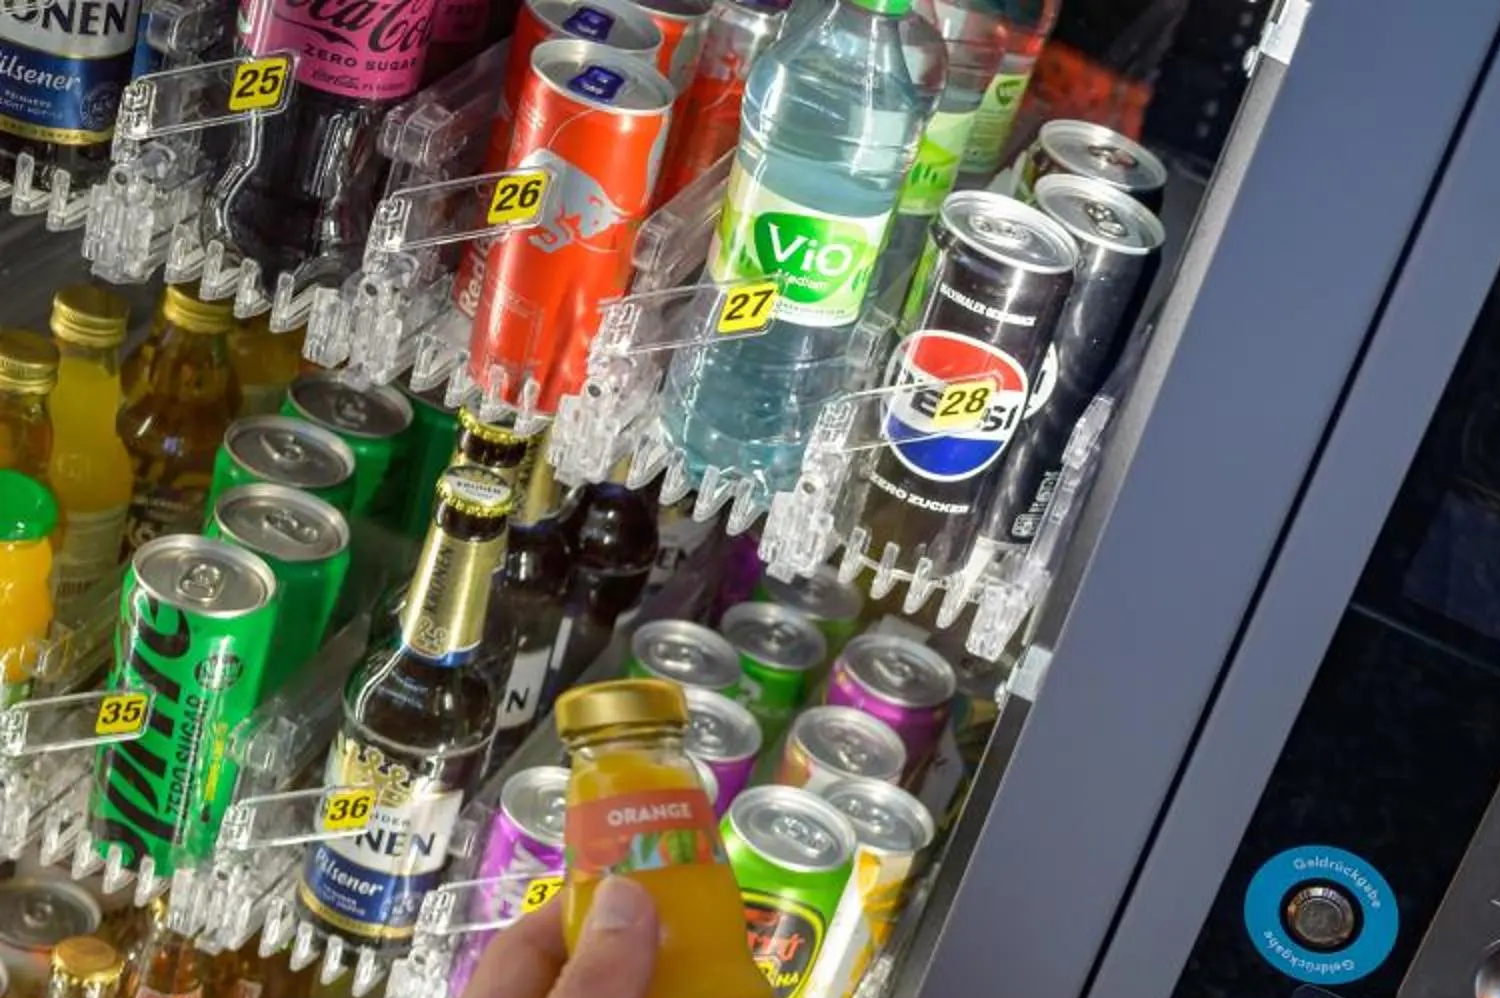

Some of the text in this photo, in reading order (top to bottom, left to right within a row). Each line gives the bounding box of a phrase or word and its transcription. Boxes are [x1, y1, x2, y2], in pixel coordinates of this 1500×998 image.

[303, 43, 417, 72] ZERO SUGAR
[234, 66, 283, 99] 25
[494, 180, 541, 213] 26
[724, 289, 774, 321] 27
[939, 387, 990, 417] 28
[906, 492, 970, 514] ZUCKER
[101, 700, 144, 724] 35
[329, 796, 369, 821] 36
[607, 803, 693, 827] ORANGE
[315, 846, 384, 897] Pilsener
[1293, 855, 1381, 909] Geldrückgabe
